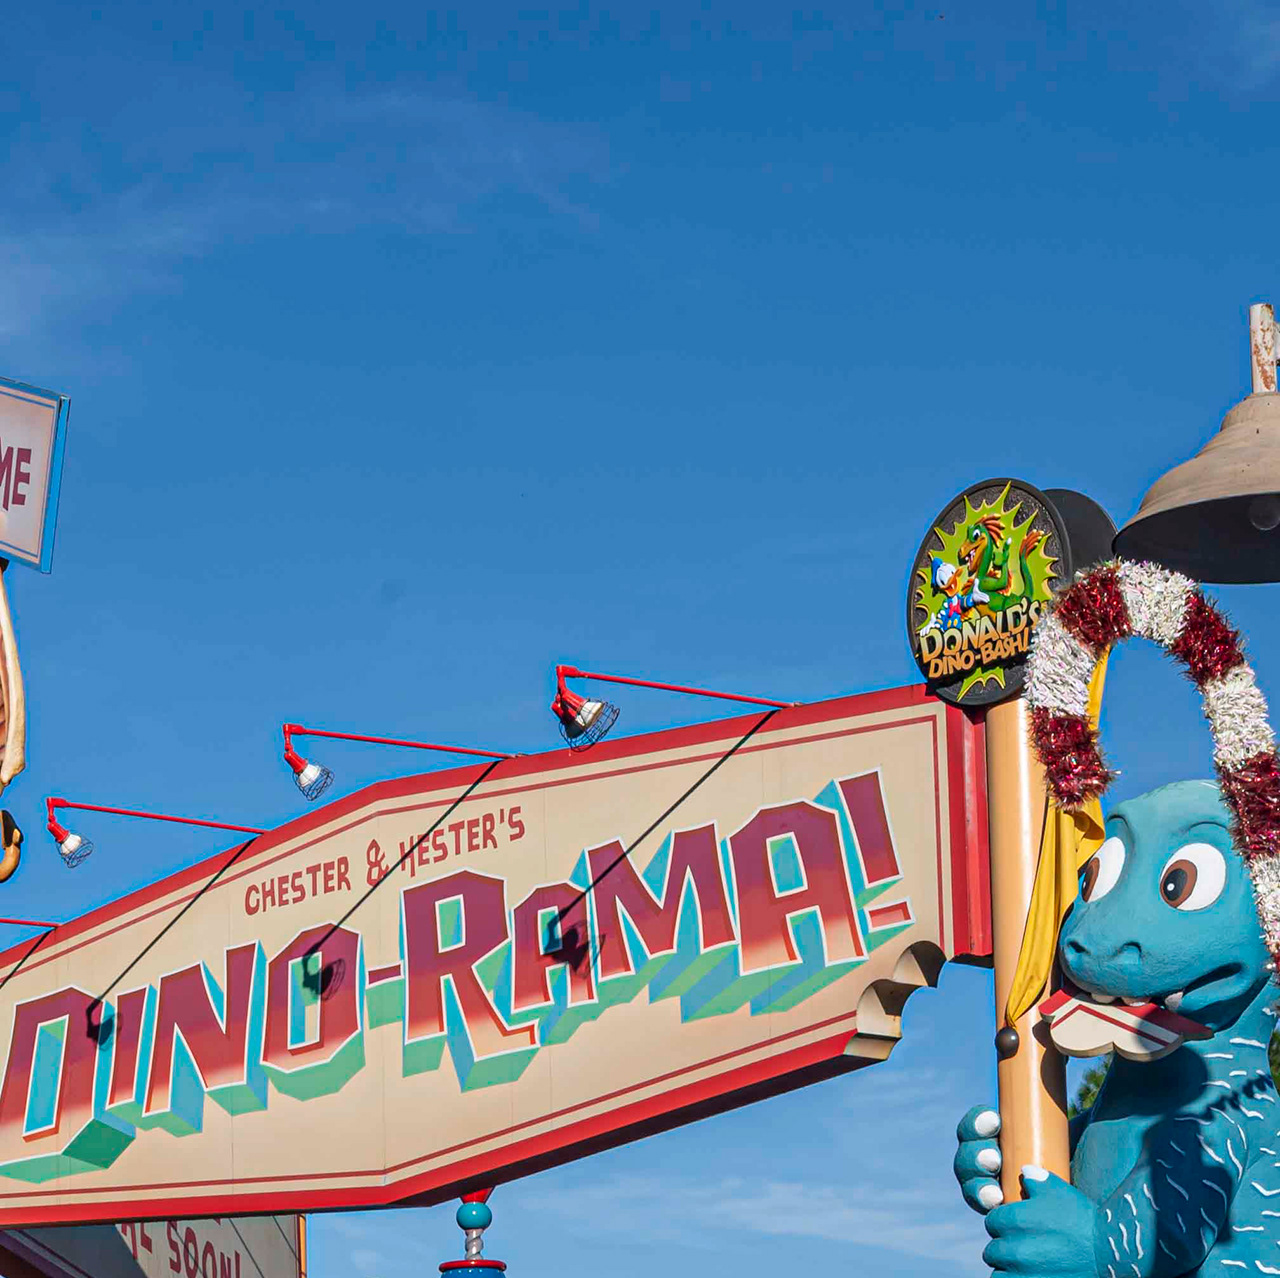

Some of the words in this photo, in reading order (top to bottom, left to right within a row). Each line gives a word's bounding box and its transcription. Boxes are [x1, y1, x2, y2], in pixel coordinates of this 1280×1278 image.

[920, 597, 1041, 662] DONALD'S
[928, 627, 1031, 679] DINO-BASH!
[244, 856, 351, 915] CHESTER
[366, 839, 389, 887] &
[399, 806, 525, 878] HESTER'S
